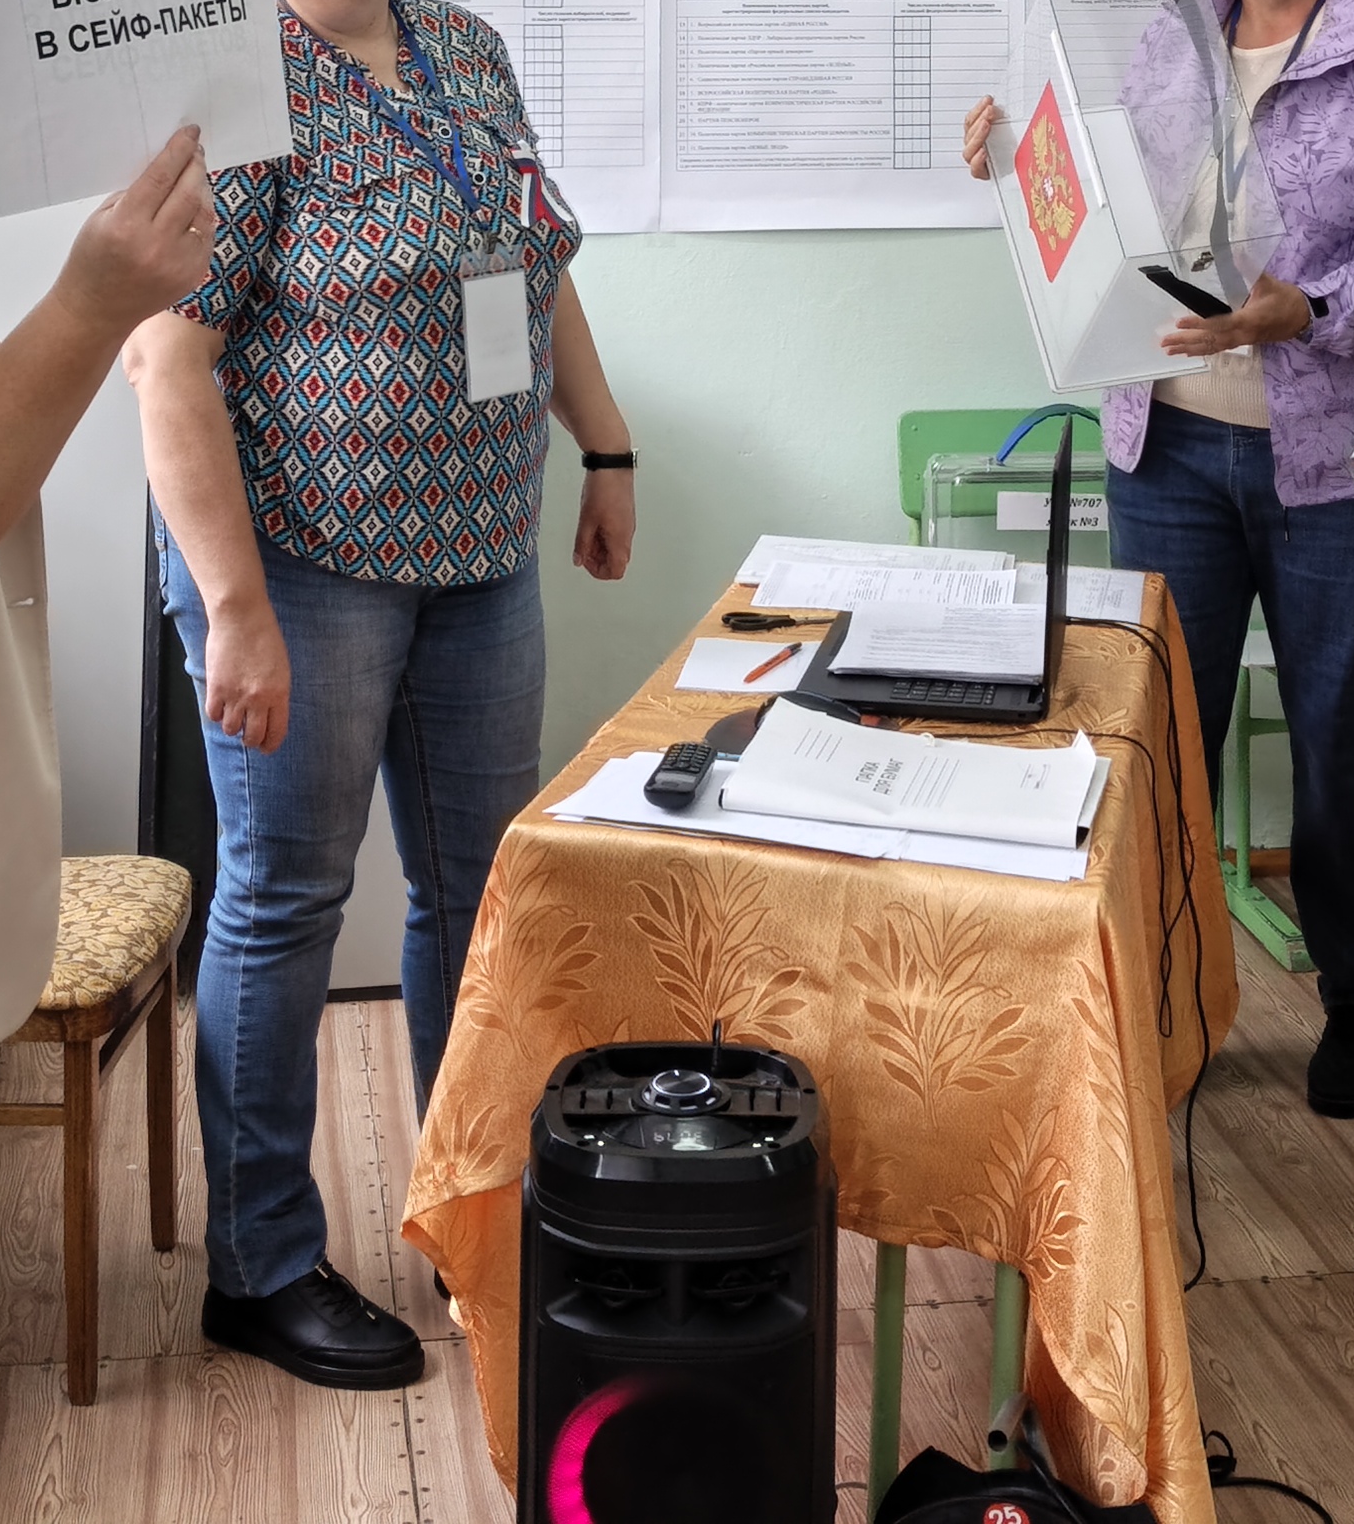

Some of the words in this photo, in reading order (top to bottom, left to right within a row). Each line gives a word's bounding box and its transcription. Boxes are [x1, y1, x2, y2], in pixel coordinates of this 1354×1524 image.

[34, 29, 59, 60] В
[1069, 497, 1103, 508] №707
[1079, 516, 1099, 527] №3
